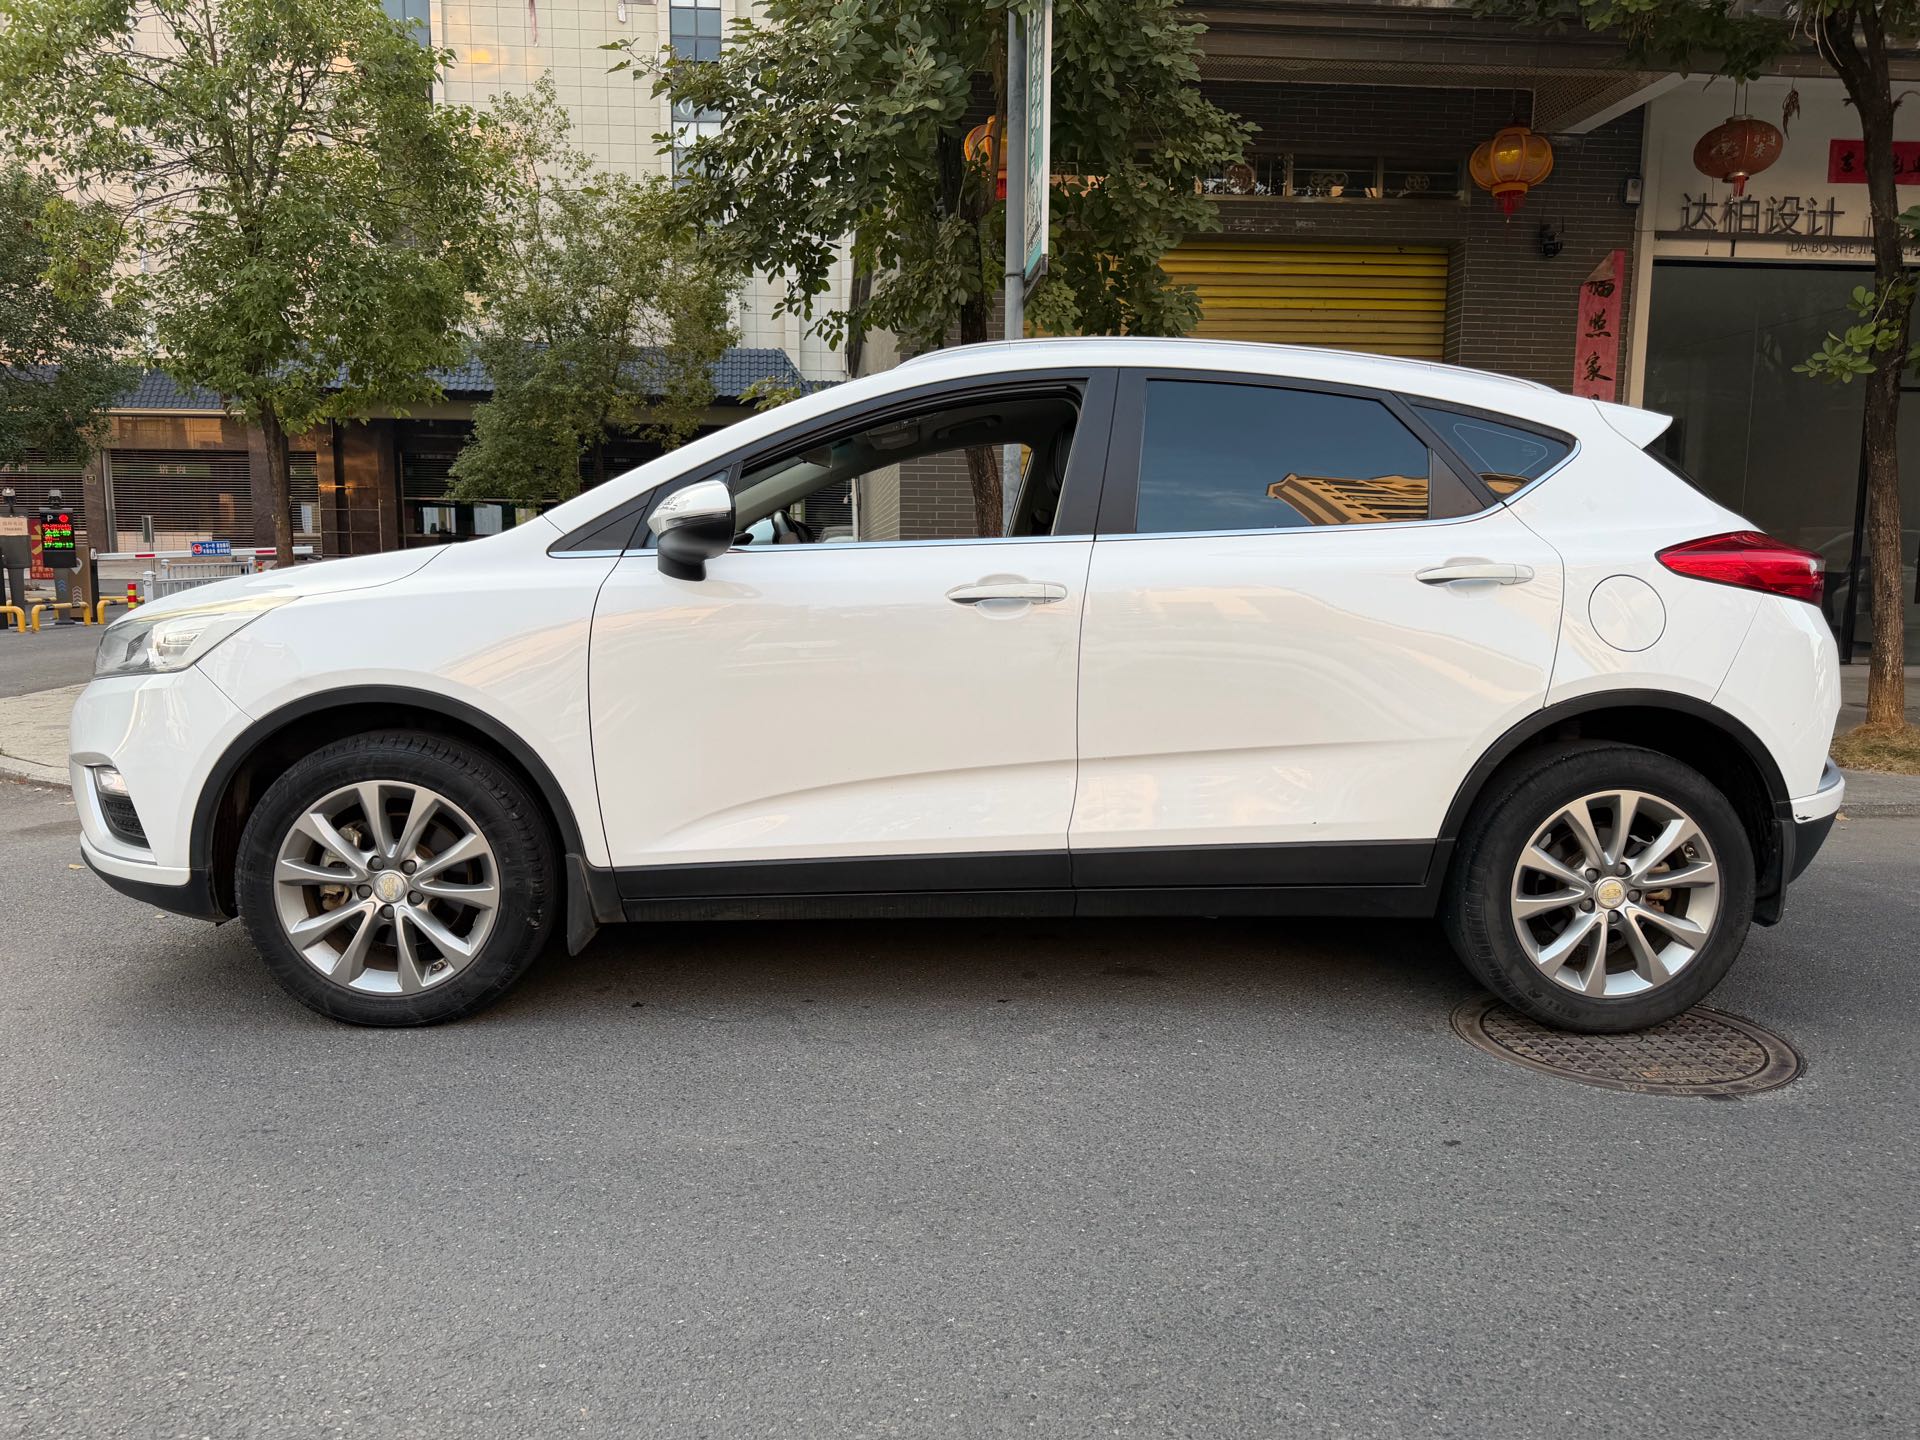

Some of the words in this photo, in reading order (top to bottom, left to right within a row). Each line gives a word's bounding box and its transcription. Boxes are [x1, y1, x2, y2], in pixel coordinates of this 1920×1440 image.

[1680, 192, 1846, 236] 达柏设计
[1790, 240, 1808, 252] DA
[1811, 240, 1829, 254] BO
[1831, 241, 1855, 254] SHE
